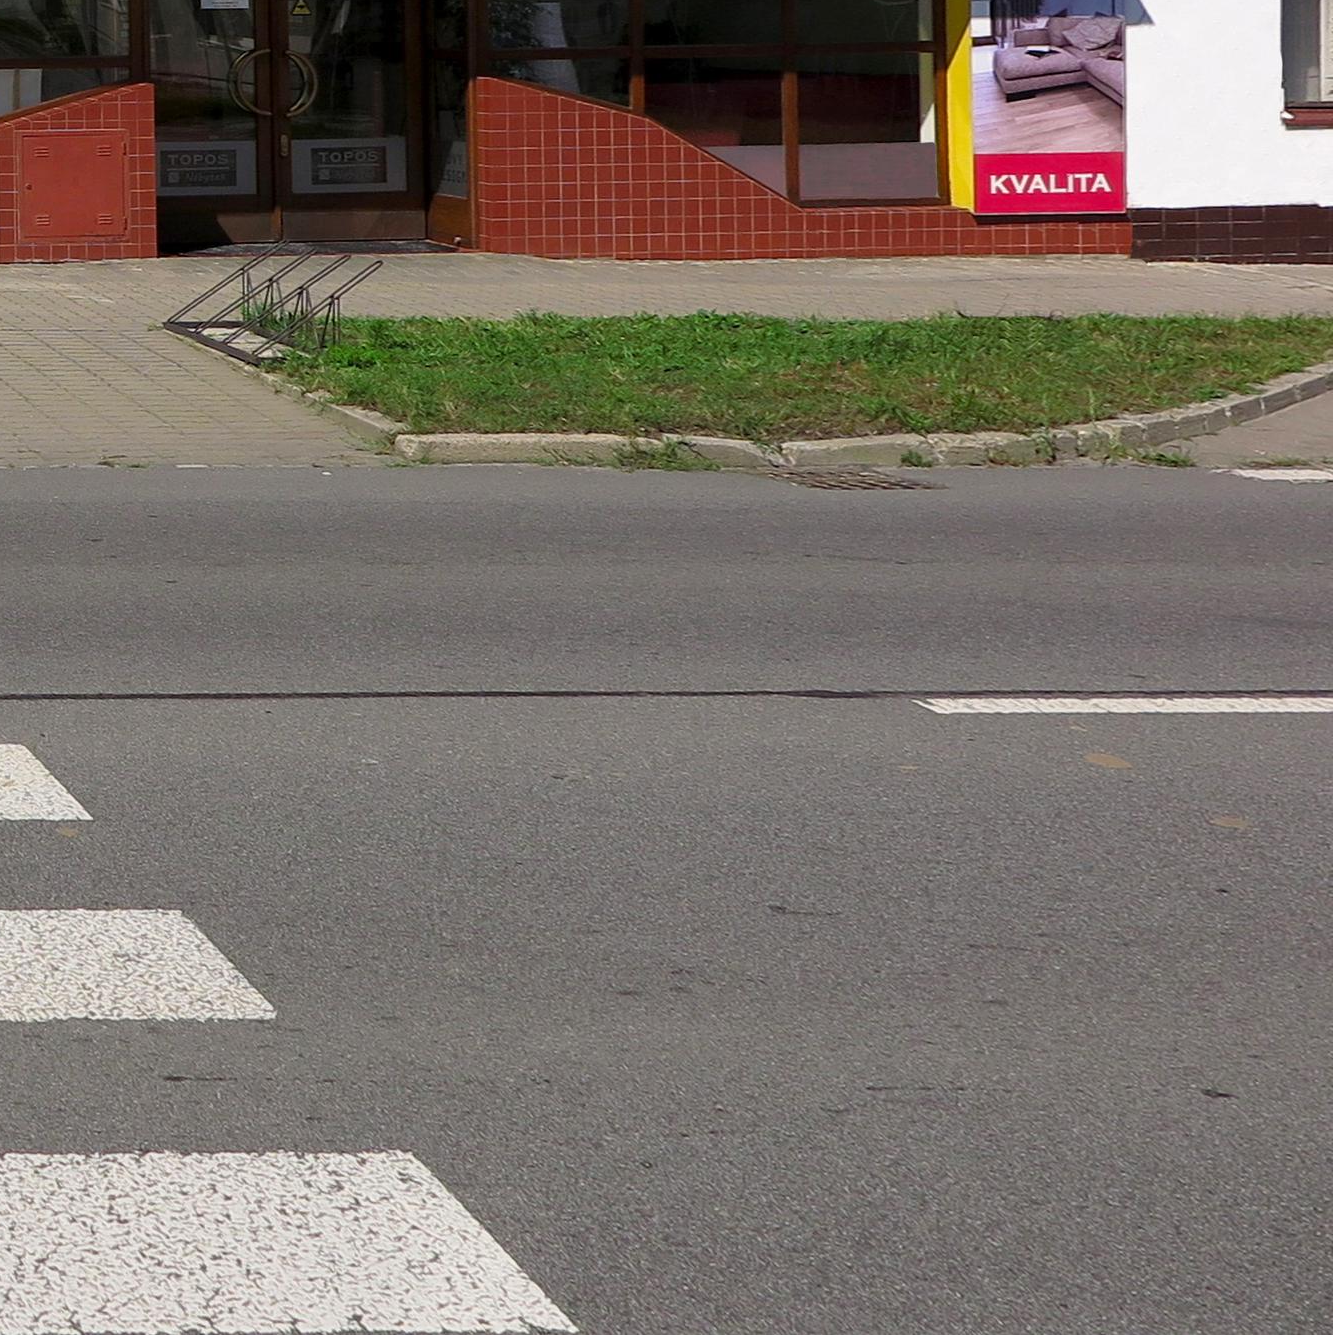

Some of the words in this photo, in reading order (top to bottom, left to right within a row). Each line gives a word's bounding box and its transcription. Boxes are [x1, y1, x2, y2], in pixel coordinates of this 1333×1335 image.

[167, 153, 230, 166] TOPOS
[318, 150, 379, 163] TOPOS
[989, 173, 1113, 194] KVALITA
